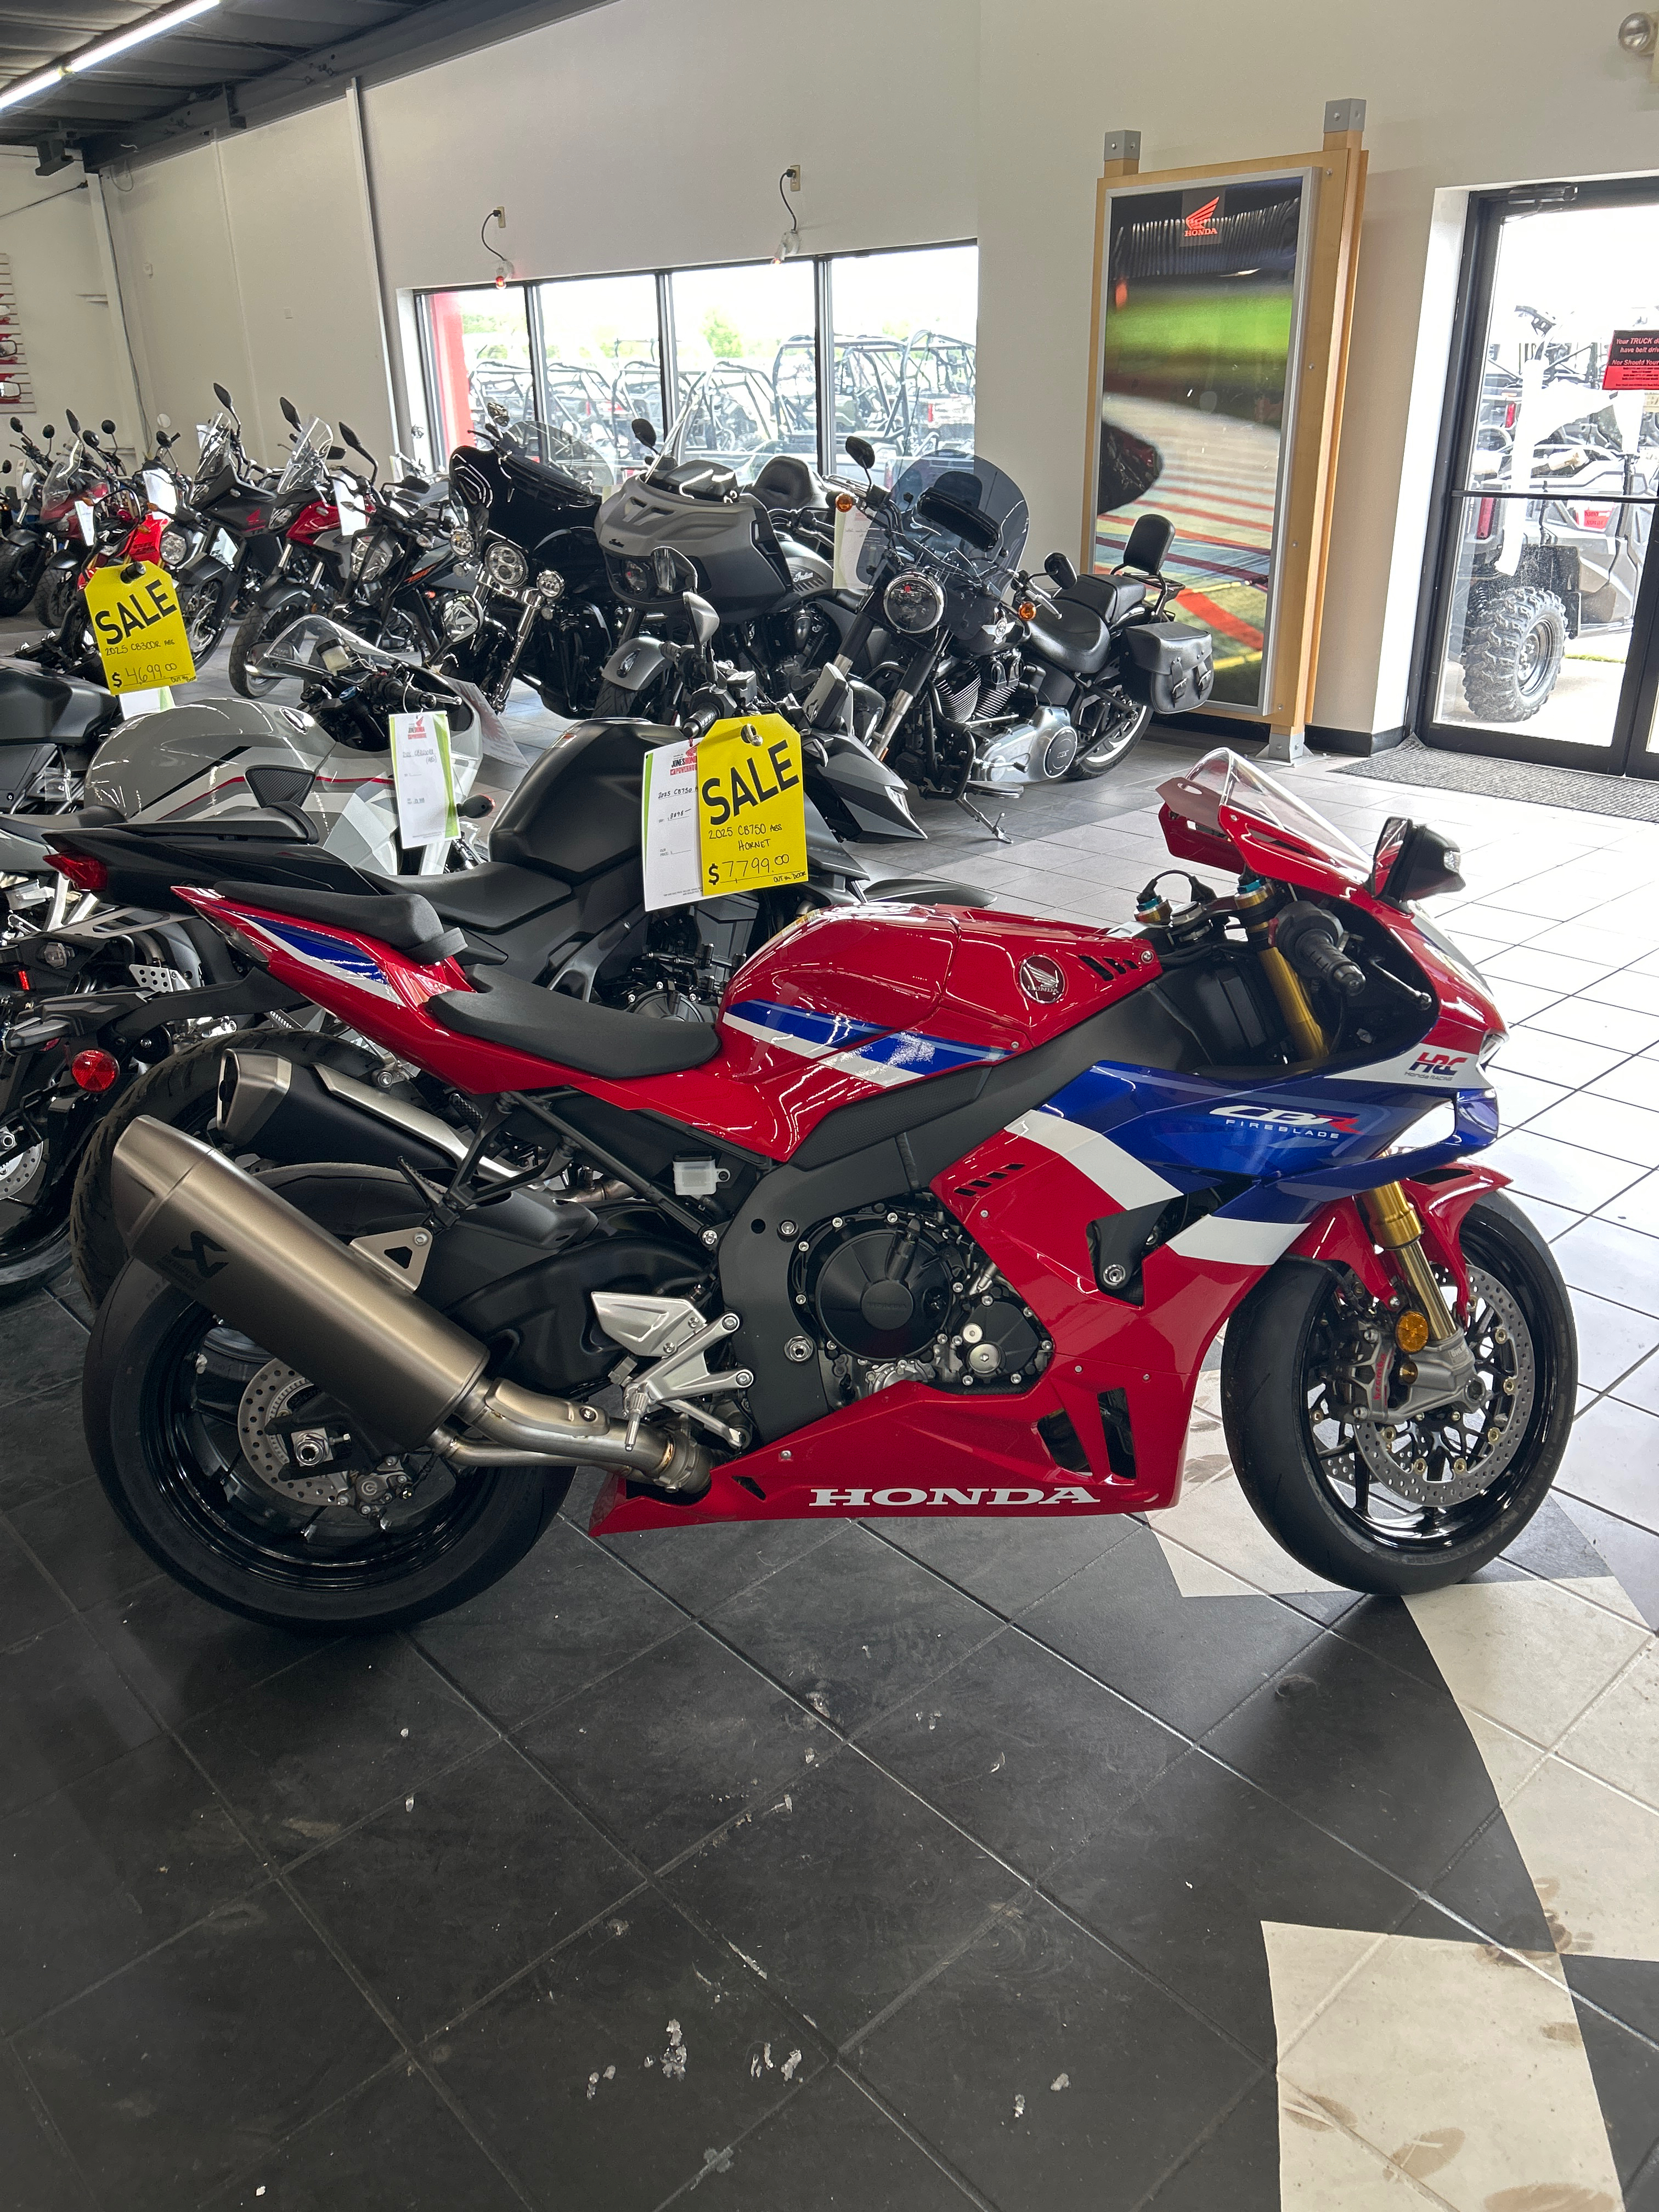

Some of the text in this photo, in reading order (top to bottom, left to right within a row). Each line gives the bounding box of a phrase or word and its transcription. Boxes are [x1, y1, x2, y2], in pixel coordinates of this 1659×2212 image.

[1184, 228, 1218, 237] HONDA
[95, 579, 178, 645] SALE
[105, 645, 128, 656] 2025
[702, 739, 800, 826] SALE
[708, 827, 733, 839] 2025
[738, 823, 766, 836] CB750
[738, 838, 771, 851] HORNET
[1408, 1052, 1468, 1076] HRC
[1225, 1119, 1340, 1139] FIREBLADE
[809, 1486, 1101, 1507] HONDA
